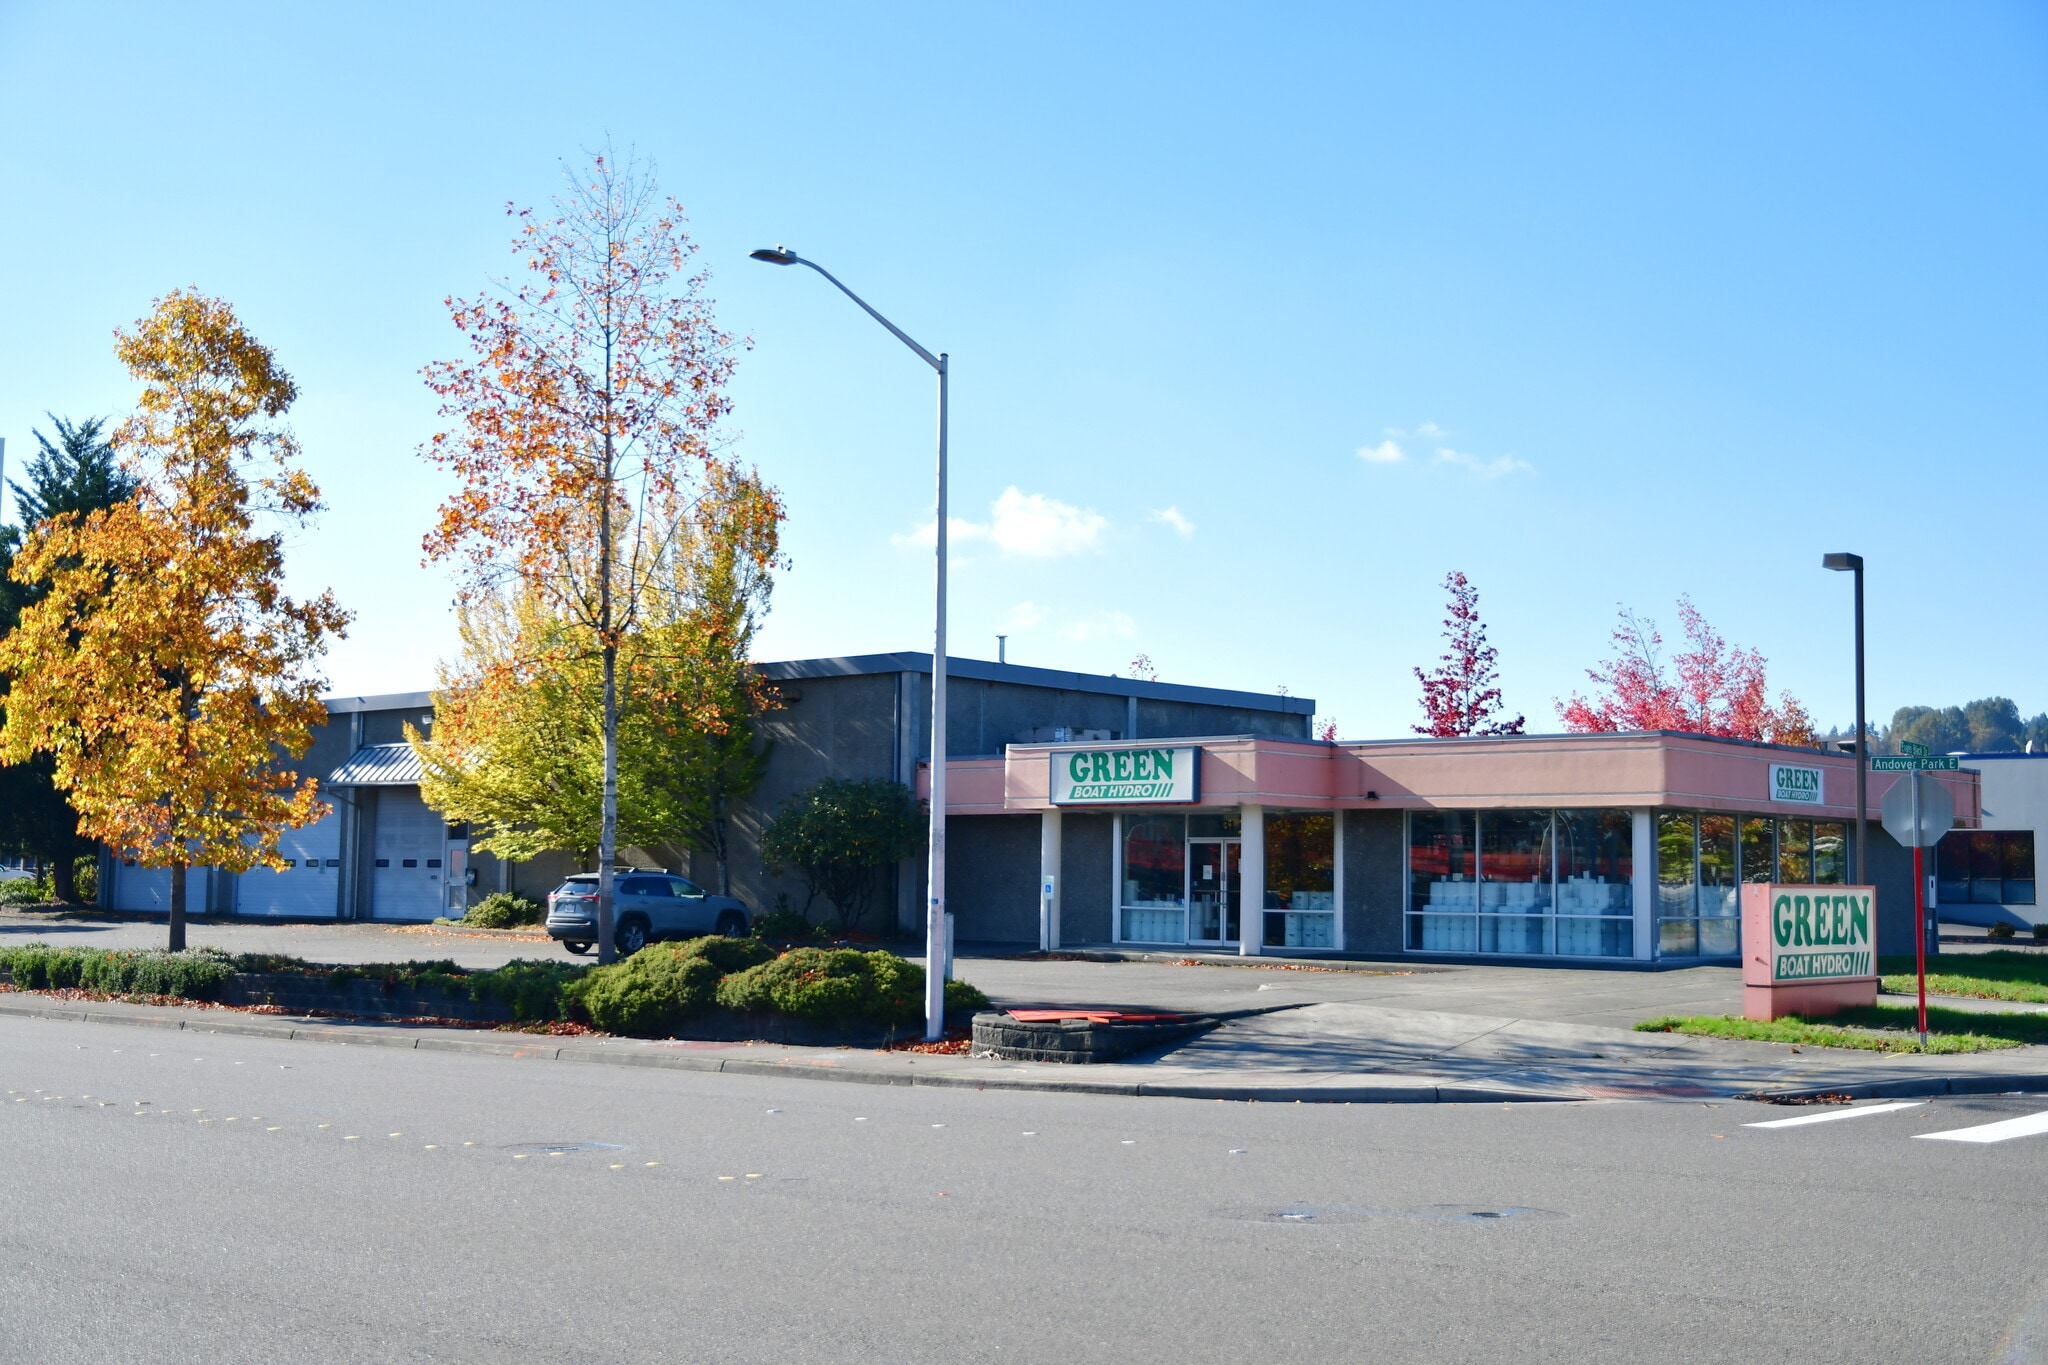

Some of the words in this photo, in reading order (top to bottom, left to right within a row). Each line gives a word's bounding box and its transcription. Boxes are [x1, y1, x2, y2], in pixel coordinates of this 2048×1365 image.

[1069, 748, 1175, 783] GREEN
[1874, 759, 1917, 770] Andover
[1921, 759, 1945, 769] Park
[1949, 758, 1955, 769] E
[1776, 767, 1818, 791] GREEN
[1074, 785, 1107, 798] BOAT
[1108, 784, 1152, 797] HYDRO
[1773, 894, 1870, 947] GREEN
[1780, 955, 1810, 976] BOAT
[1812, 954, 1851, 974] HYDRO
